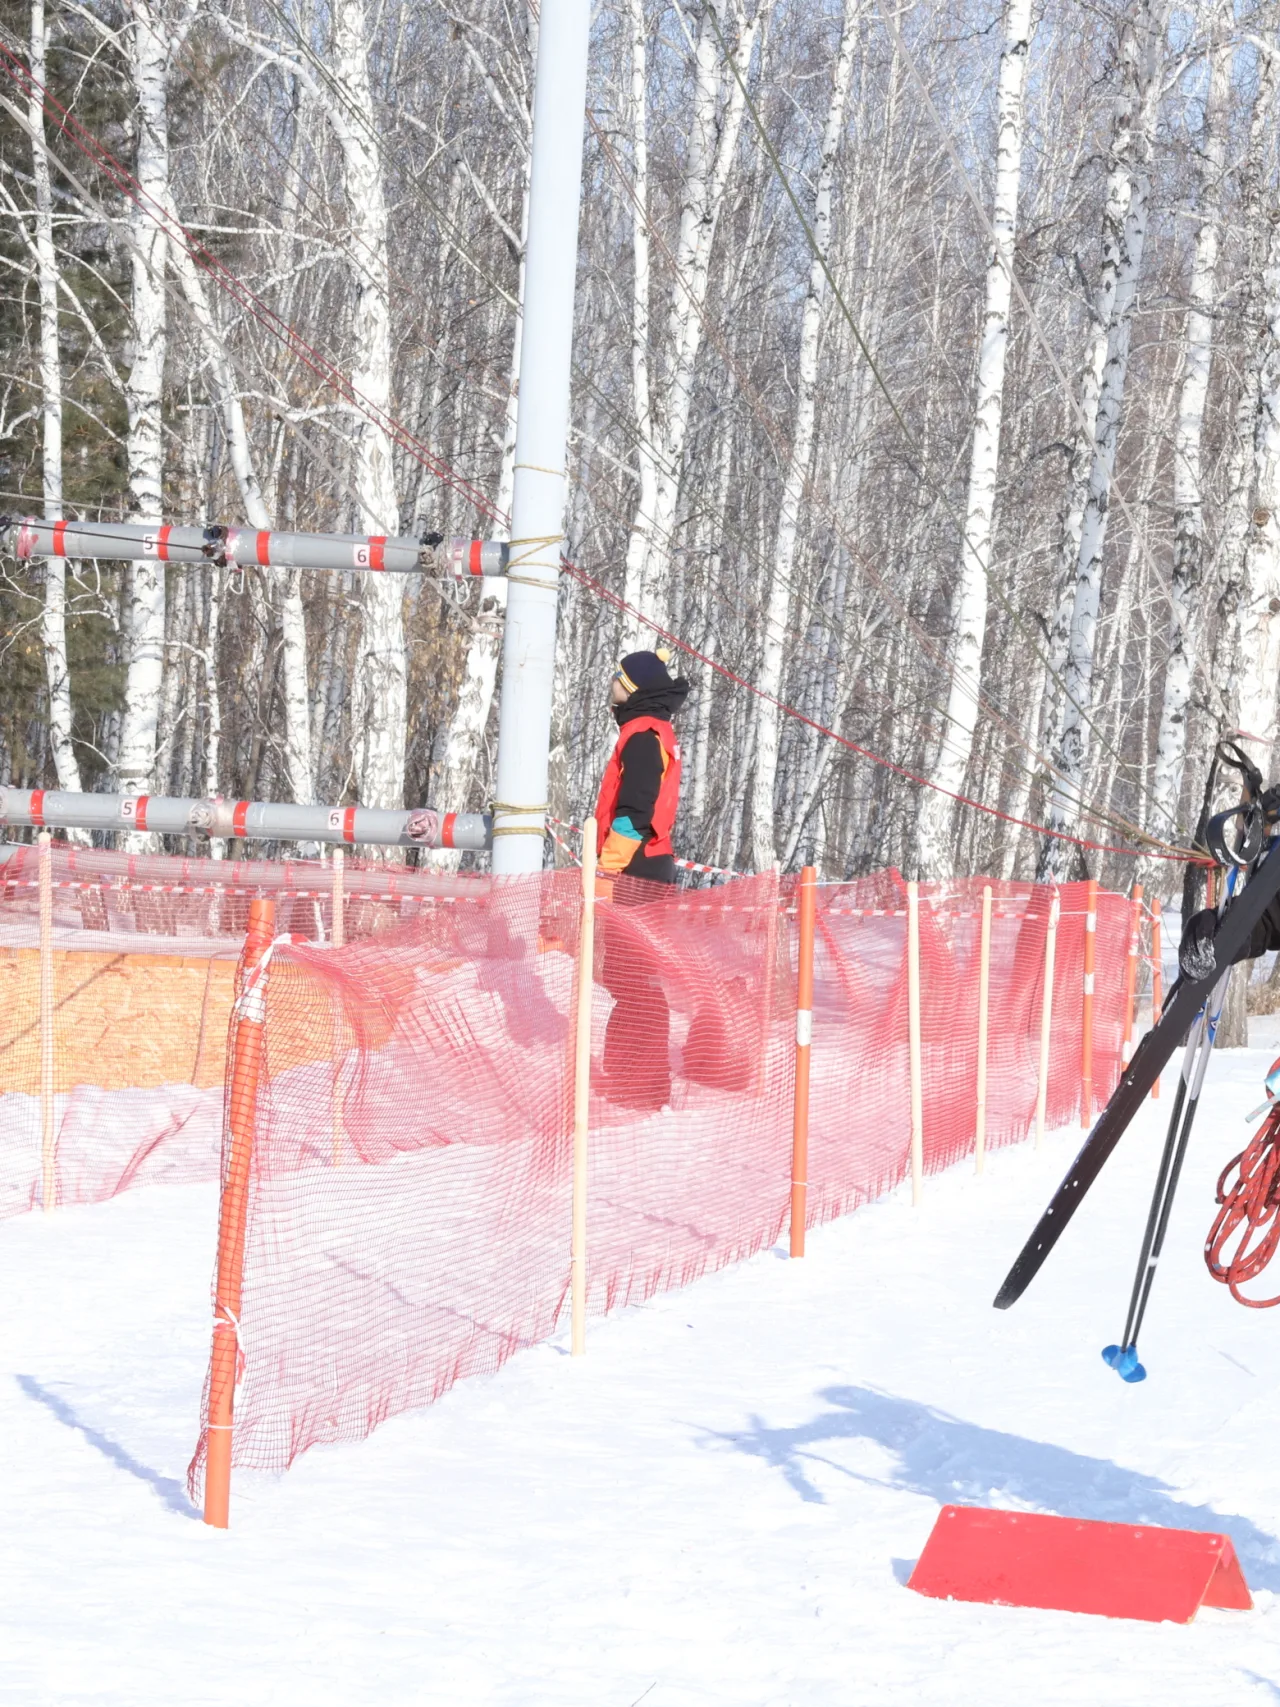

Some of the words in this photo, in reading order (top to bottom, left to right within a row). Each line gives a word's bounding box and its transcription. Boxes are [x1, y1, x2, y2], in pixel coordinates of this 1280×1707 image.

[144, 536, 153, 550] 5
[357, 549, 367, 563] 6
[123, 802, 133, 815] 5
[330, 812, 339, 826] 6
